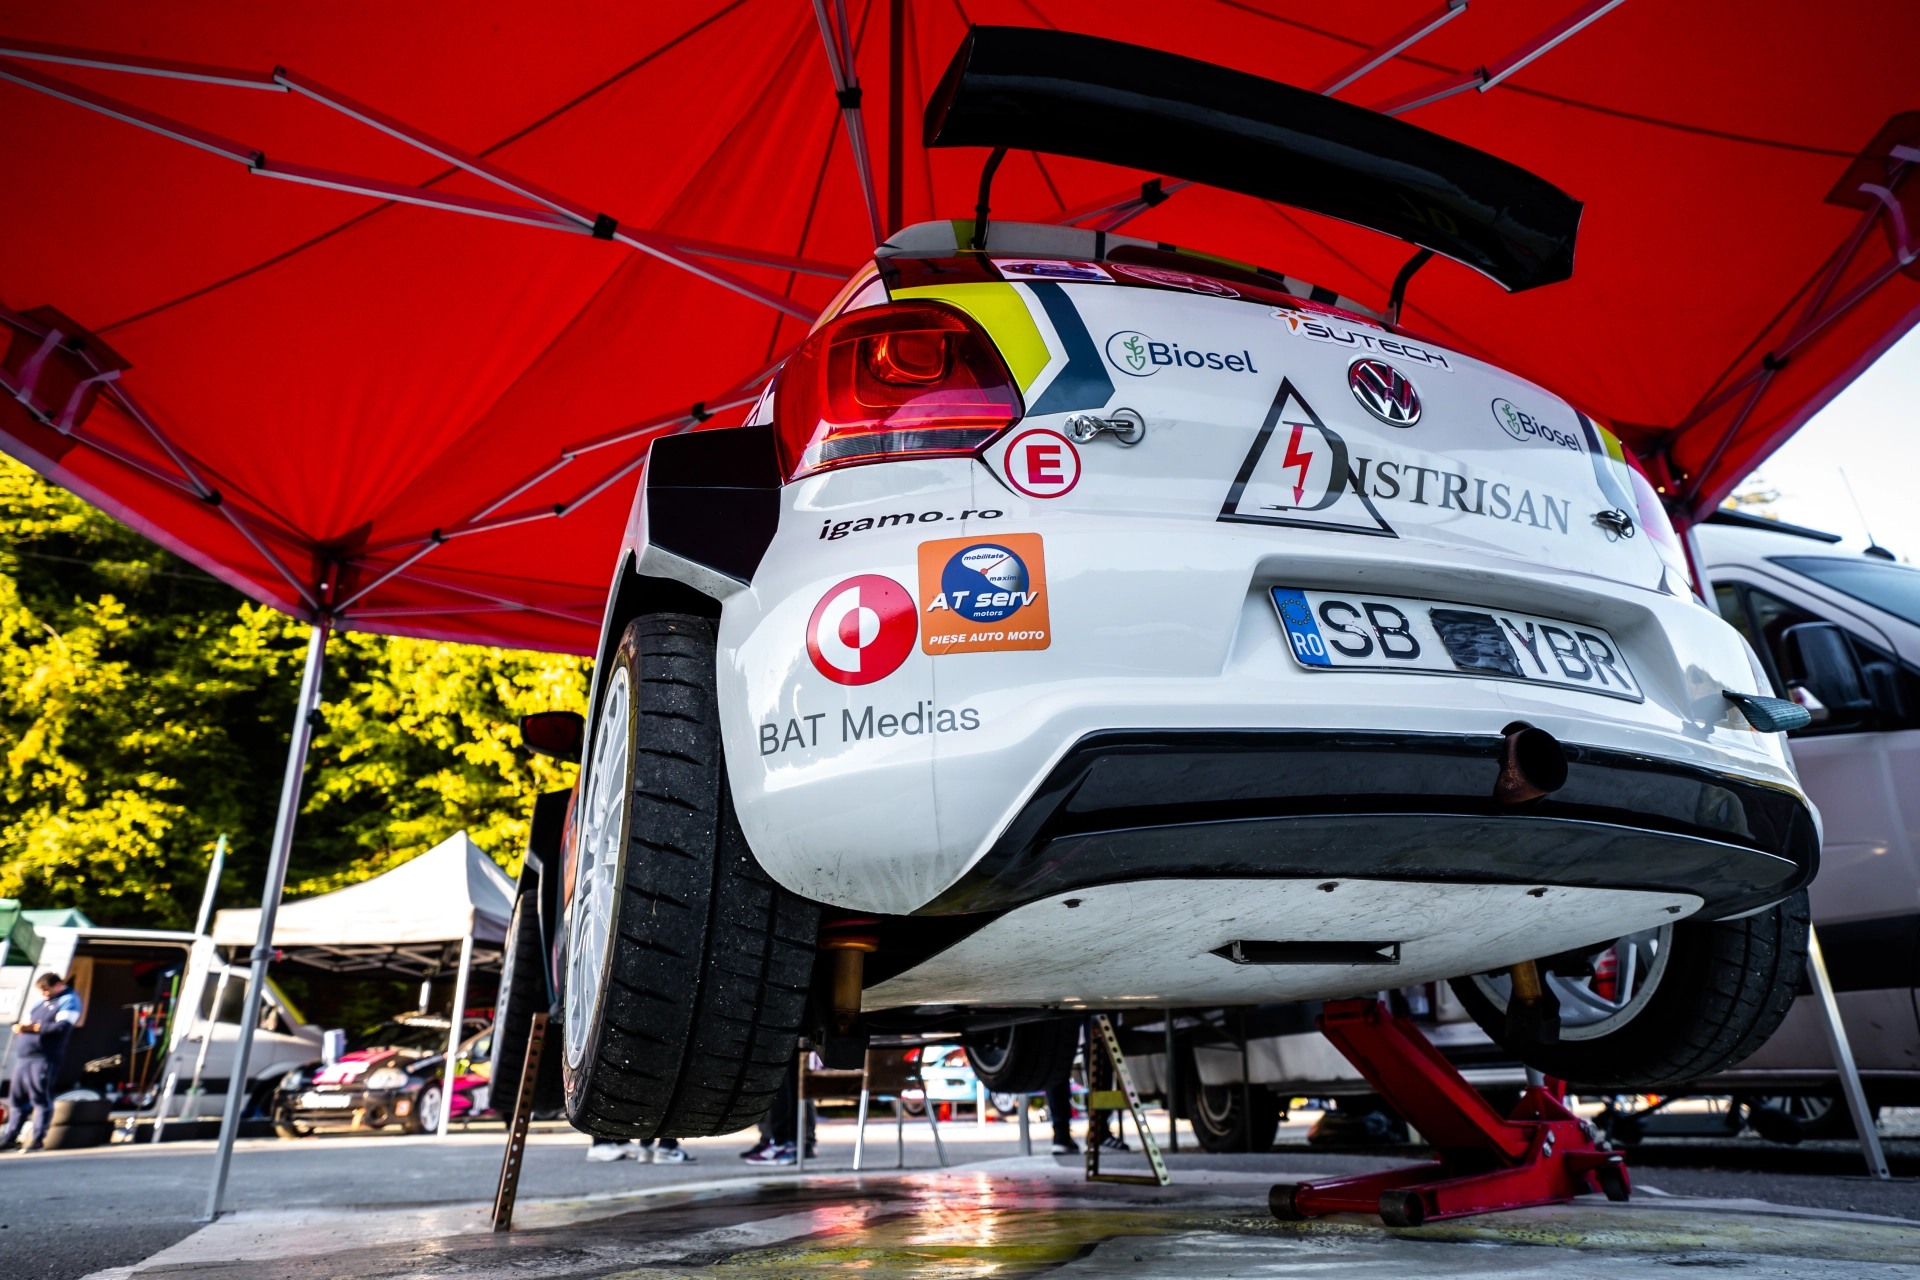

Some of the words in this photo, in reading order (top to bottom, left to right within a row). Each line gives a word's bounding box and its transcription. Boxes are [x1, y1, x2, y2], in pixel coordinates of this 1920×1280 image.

[1149, 341, 1258, 374] Biosel
[1303, 322, 1449, 369] SUTECH
[1516, 411, 1586, 456] Biosel
[1025, 445, 1064, 484] E
[818, 508, 1004, 541] igamo.ro
[963, 553, 1004, 561] mobilitate
[926, 590, 970, 612] AT
[974, 591, 1038, 608] serv
[929, 633, 967, 645] PIESE
[969, 631, 1004, 642] AUTO
[1007, 630, 1045, 640] MOTO
[1291, 631, 1324, 657] RO
[1318, 600, 1421, 660] SB
[1499, 616, 1632, 691] YBR
[760, 714, 826, 756] BAT
[842, 700, 981, 743] Medias
